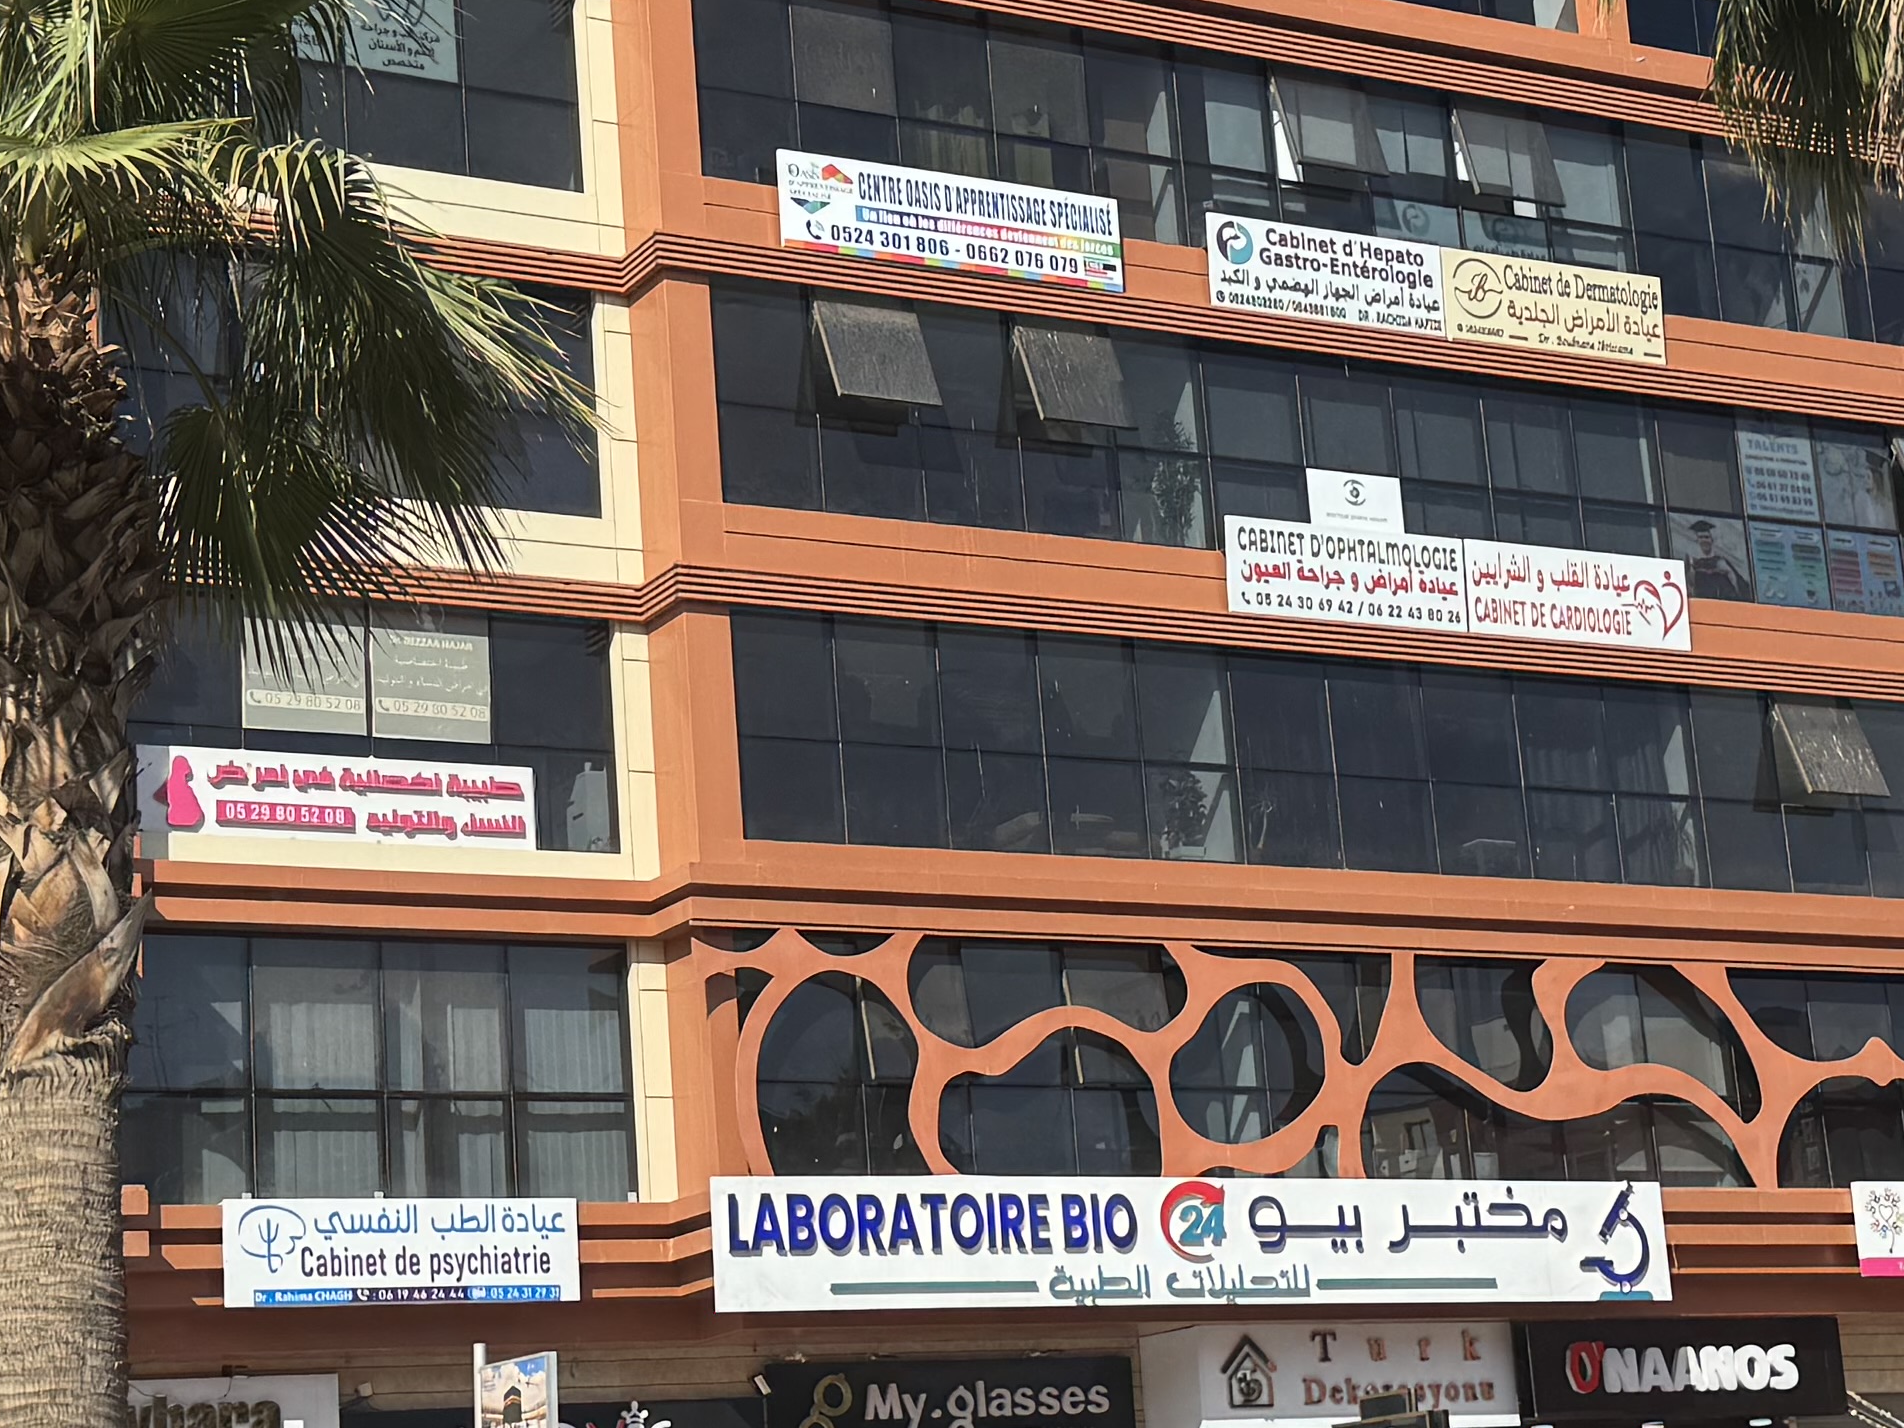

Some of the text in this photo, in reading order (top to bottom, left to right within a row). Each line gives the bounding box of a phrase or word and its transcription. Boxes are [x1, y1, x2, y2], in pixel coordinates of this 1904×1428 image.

[858, 171, 1114, 237] CENTRE OASIS D'APPRENTISSAGE SPÉCIALISÉ
[918, 215, 936, 231] les
[831, 224, 874, 246] 0524
[879, 231, 911, 251] 301
[916, 236, 950, 256] 806
[966, 243, 1010, 264] 0662
[1015, 250, 1044, 269] 076
[1049, 255, 1078, 274] 079
[1265, 228, 1337, 256] Cabinet
[1220, 268, 1250, 288] الكبد
[1254, 275, 1261, 291] و
[1259, 247, 1434, 290] Gastro-Entérologie
[1266, 276, 1318, 298] الهضمي
[1364, 286, 1405, 310] أمراض
[1409, 291, 1440, 314] عيادة
[1503, 264, 1658, 315] Cabinet de Dermatologie
[1507, 299, 1661, 343] عيادة الأمراض الجلدية
[1746, 439, 1798, 455] TALENTS
[1237, 525, 1458, 573] CABINET D'OPHTALMOLOGIE
[1241, 559, 1291, 584] العيون
[1297, 559, 1345, 591] جراحة
[1351, 571, 1359, 592] و
[1419, 567, 1459, 601] عيادة
[1472, 552, 1631, 598] عيادة القلب و الشرايين
[1256, 592, 1272, 607] 05
[1277, 593, 1292, 608] 24
[1297, 595, 1314, 610] 30
[1318, 597, 1333, 612] 69
[1338, 600, 1353, 615] 42
[1368, 603, 1383, 617] 06
[1388, 604, 1403, 619] 22
[1408, 606, 1422, 621] 43
[1447, 609, 1461, 624] 26
[1474, 596, 1632, 636] CABINET DE CARDIOLOGIE
[326, 696, 342, 710] 52
[345, 698, 361, 711] 08
[394, 700, 409, 713] 05
[414, 701, 429, 714] 29
[452, 704, 467, 717] 52
[470, 706, 486, 719] 08
[225, 803, 345, 824] 05 29 80 52 08
[314, 1203, 565, 1241] عيادة الطب النفسي
[727, 1192, 1227, 1257] LABORATOIRE BIO 24
[1248, 1185, 1569, 1255] مختبر بيو
[301, 1244, 552, 1283] Cabinet de psychiatrie
[275, 1291, 313, 1304] Rahima
[378, 1290, 394, 1301] 06
[397, 1289, 409, 1301] 19
[413, 1289, 427, 1300] 46
[431, 1288, 446, 1300] 24
[449, 1288, 464, 1300] 44
[489, 1287, 504, 1299] 05
[507, 1287, 521, 1299] 24
[1049, 1264, 1311, 1306] للتحليلات الطبية
[1566, 1341, 1799, 1394] O'NAANOS
